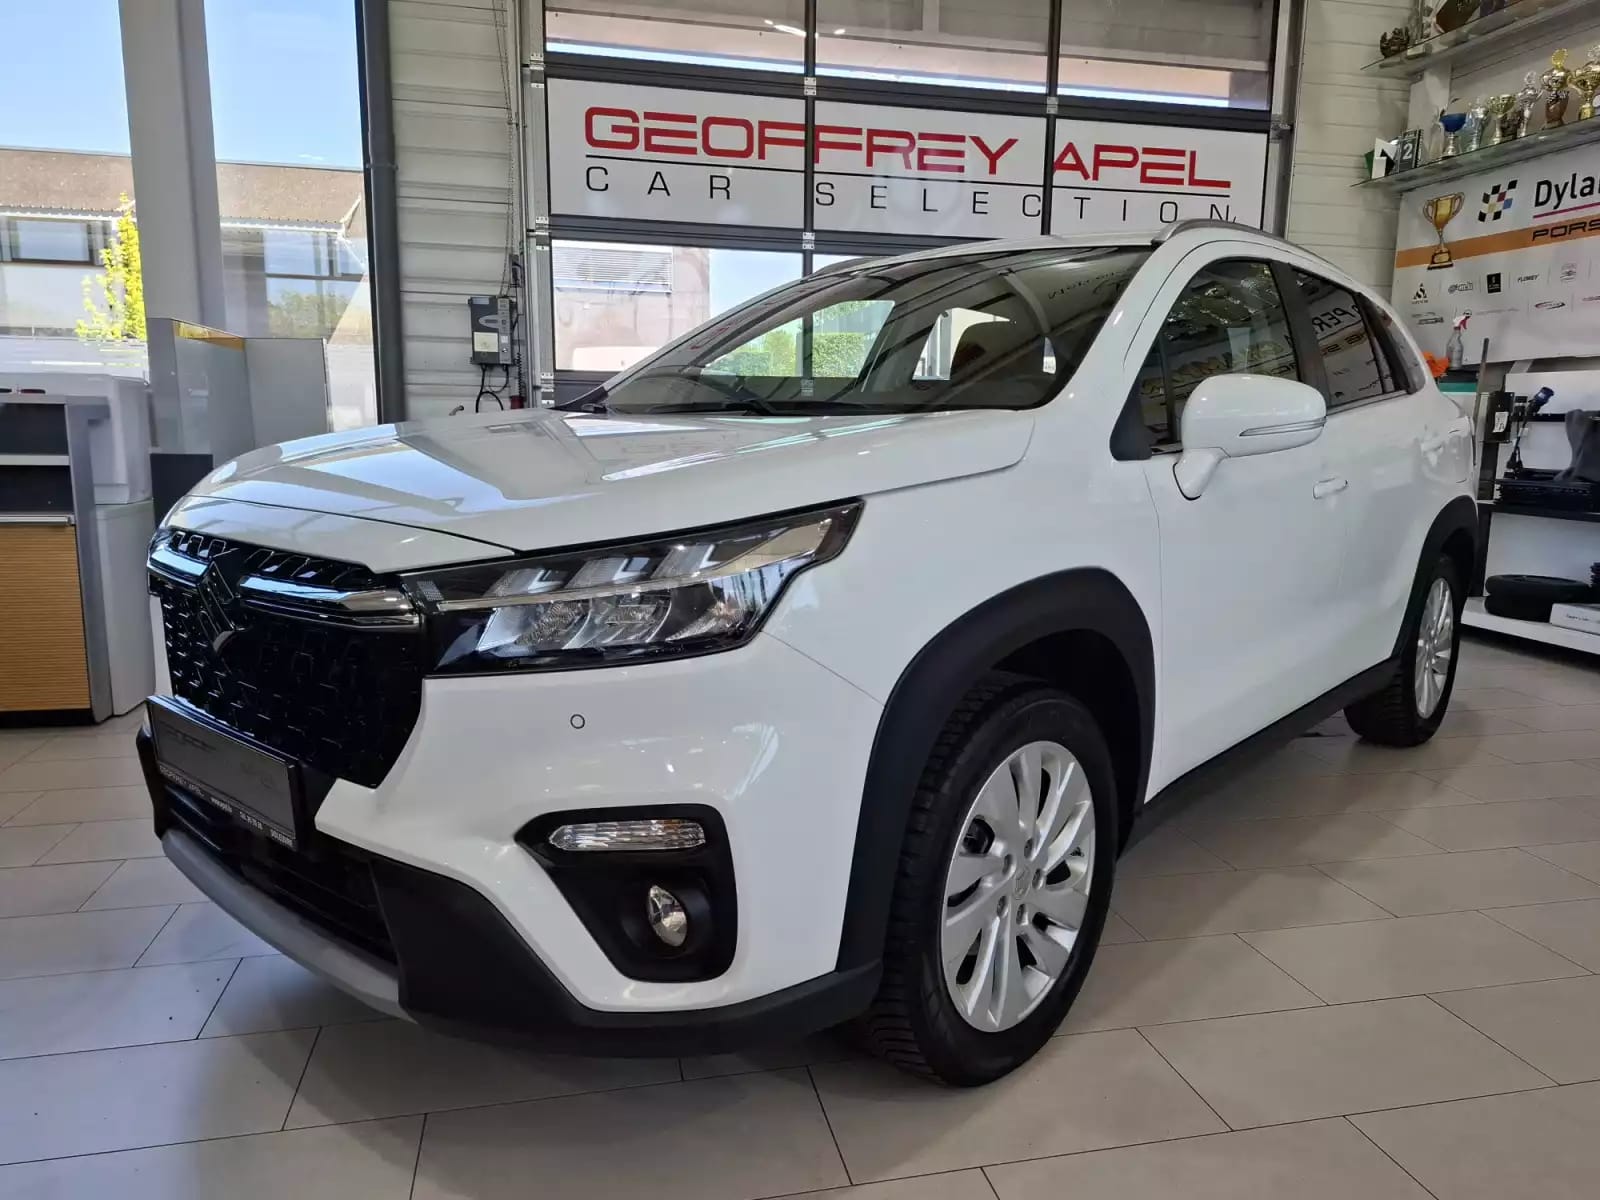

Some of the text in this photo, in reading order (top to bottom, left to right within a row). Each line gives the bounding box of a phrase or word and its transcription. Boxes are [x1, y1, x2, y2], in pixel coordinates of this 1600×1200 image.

[585, 107, 1231, 188] GEOFFREY APEL
[1402, 143, 1413, 160] 2
[585, 166, 1229, 224] CAR SELECTION
[1535, 173, 1600, 210] Dyla
